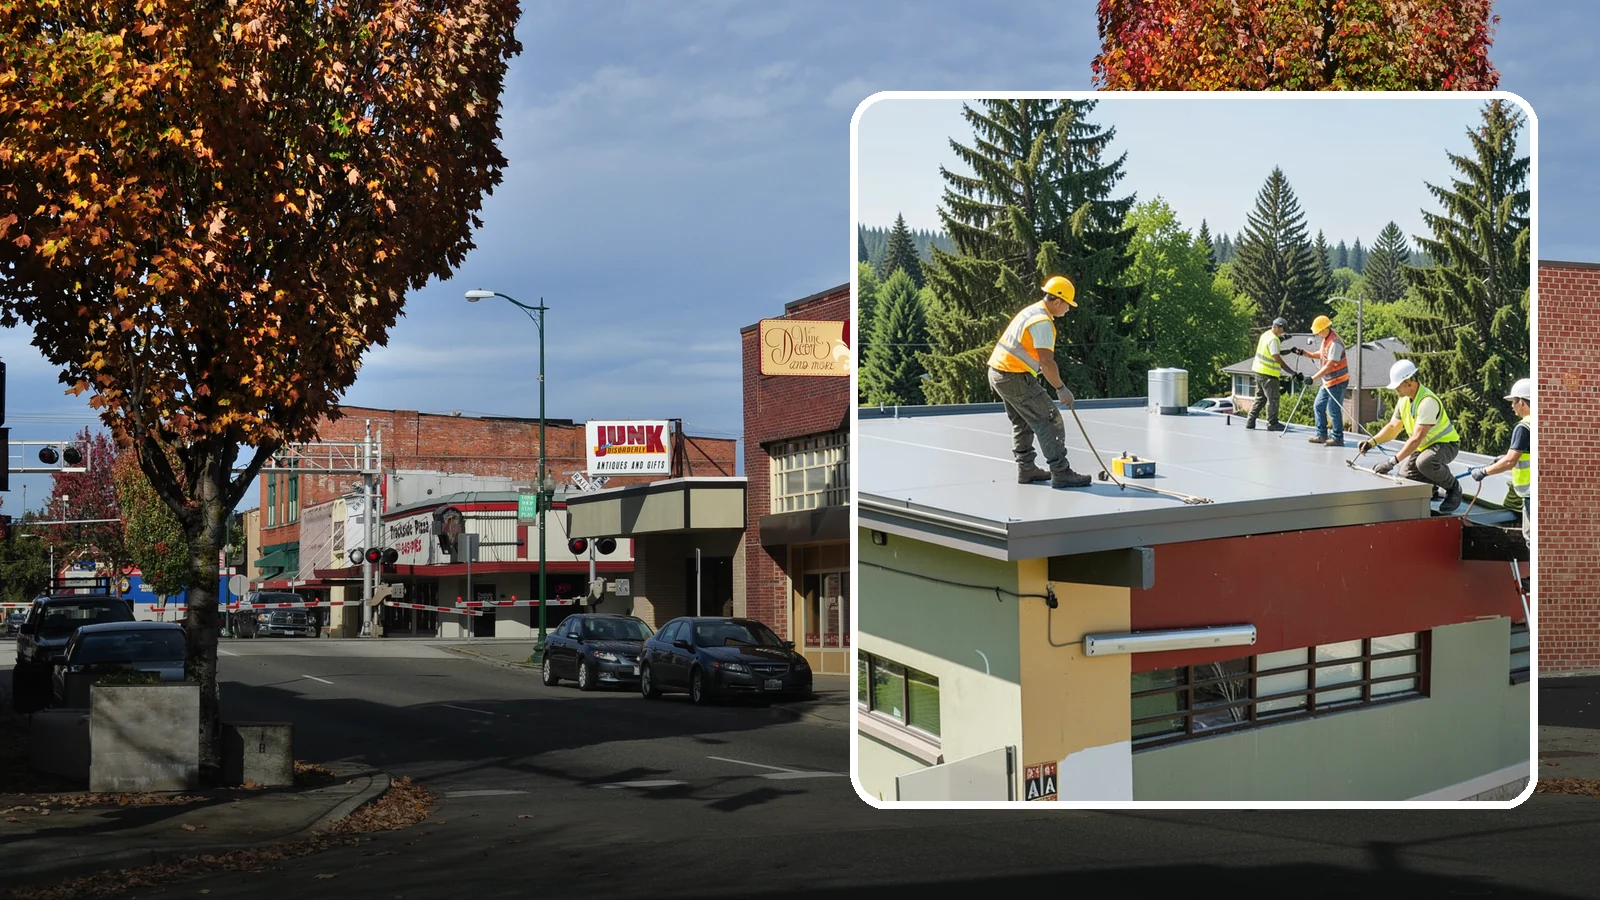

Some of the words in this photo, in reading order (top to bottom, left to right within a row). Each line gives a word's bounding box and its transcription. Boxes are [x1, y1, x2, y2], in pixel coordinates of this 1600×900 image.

[596, 425, 665, 457] JUNK
[607, 446, 645, 454] DISORDERLY
[597, 461, 628, 470] ANTIQUES
[631, 461, 644, 470] AND
[647, 460, 666, 469] GIFTS
[573, 473, 588, 491] RAIL
[390, 520, 413, 540] Trackside
[414, 519, 429, 535] Pizza
